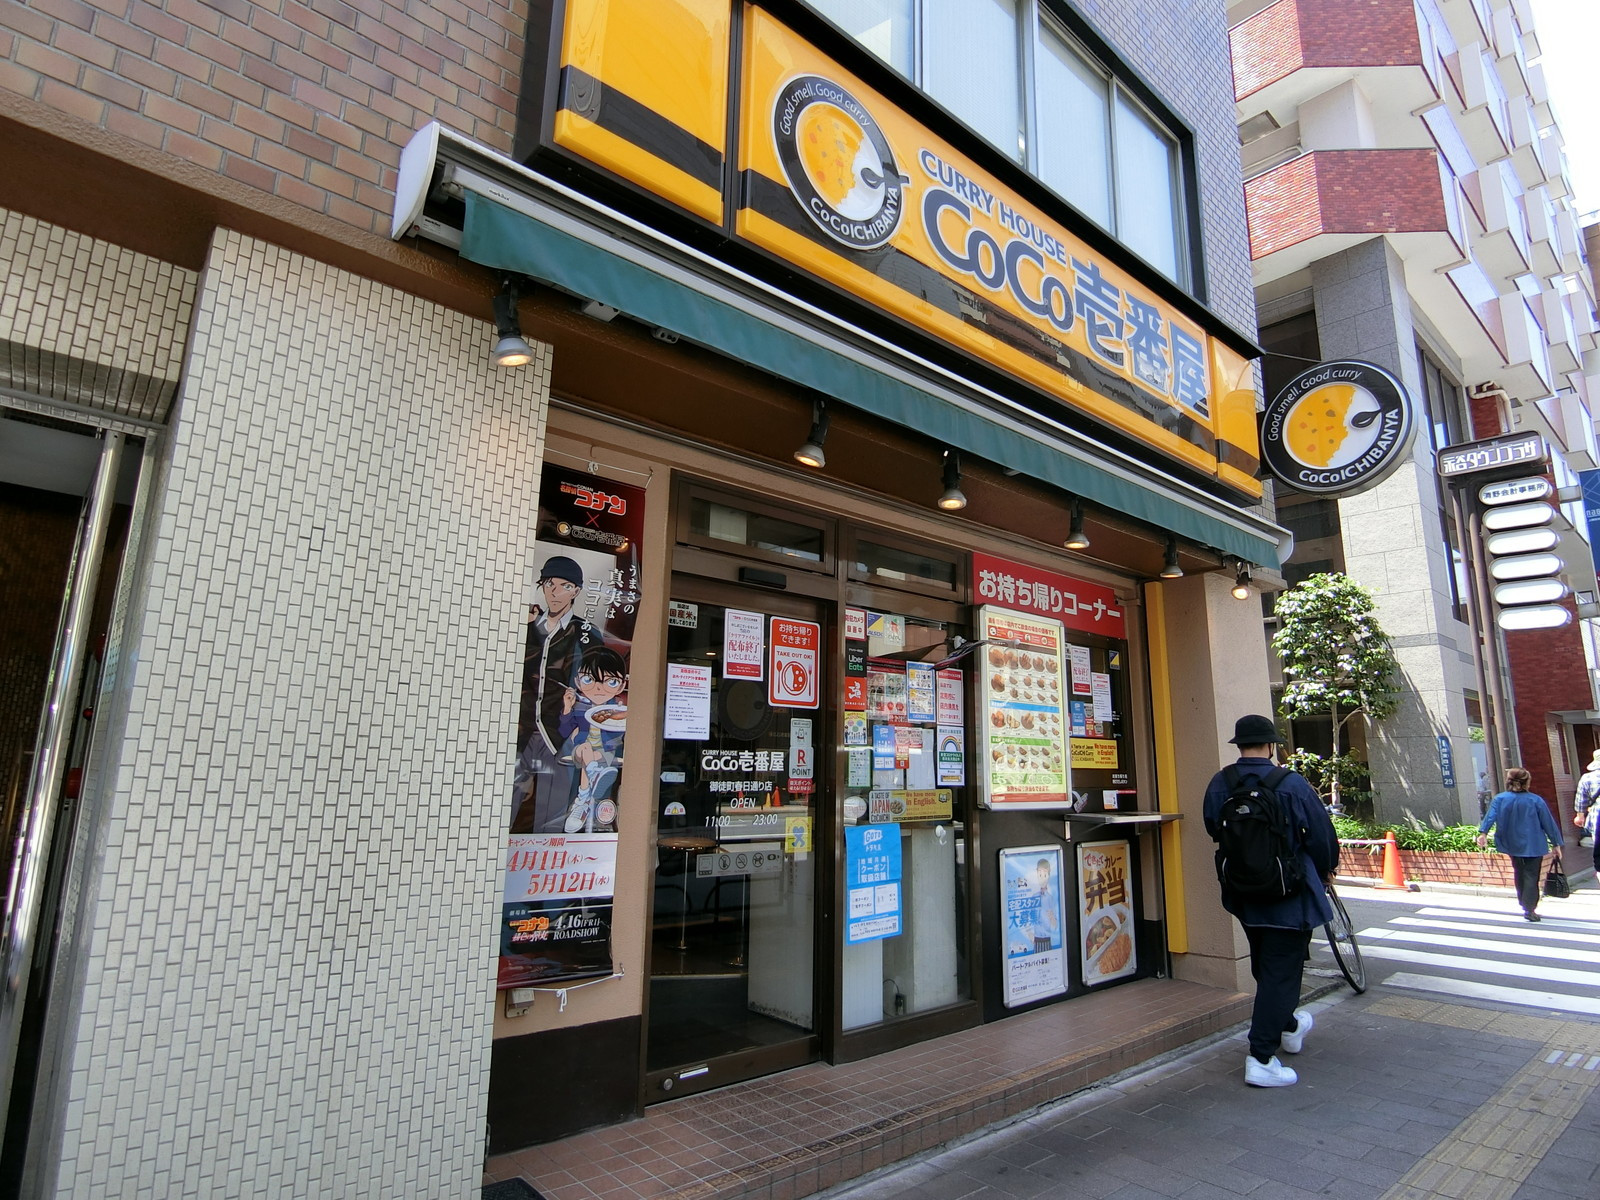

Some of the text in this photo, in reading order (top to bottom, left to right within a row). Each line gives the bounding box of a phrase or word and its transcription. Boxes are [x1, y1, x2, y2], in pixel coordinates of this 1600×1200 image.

[779, 99, 795, 135] Good
[816, 83, 843, 103] Good
[844, 99, 871, 127] curry
[810, 187, 898, 240] CoCoICHIBANYA
[920, 149, 1067, 266] CURRY HOUSE
[923, 187, 1211, 420] CoCo壱番屋
[1268, 369, 1362, 441] Good smell. Good curry
[1299, 408, 1399, 484] CoCoICHIBANYA
[604, 568, 625, 619] 真実は
[623, 564, 637, 614] うまさの
[978, 569, 1121, 622] お持ち帰りコーナー
[580, 578, 603, 644] ココにある
[778, 623, 812, 636] お持ち帰り
[728, 640, 760, 653] 配布終了
[848, 654, 864, 663] Uber
[848, 662, 864, 671] Eats
[701, 750, 784, 772] CoCo壱番屋
[797, 749, 807, 764] R
[792, 768, 811, 776] POINT
[709, 780, 773, 792] 御徒町春日通り店
[874, 791, 885, 799] TASTE
[730, 797, 756, 809] OPEN
[871, 799, 890, 814] JAPAN
[705, 815, 731, 828] 11:00
[752, 813, 778, 826] 23:00
[507, 837, 566, 847] キャンペーン期間
[860, 863, 887, 874] クーポン
[1084, 867, 1125, 912] 弁当
[552, 927, 600, 940] ROADSHOW
